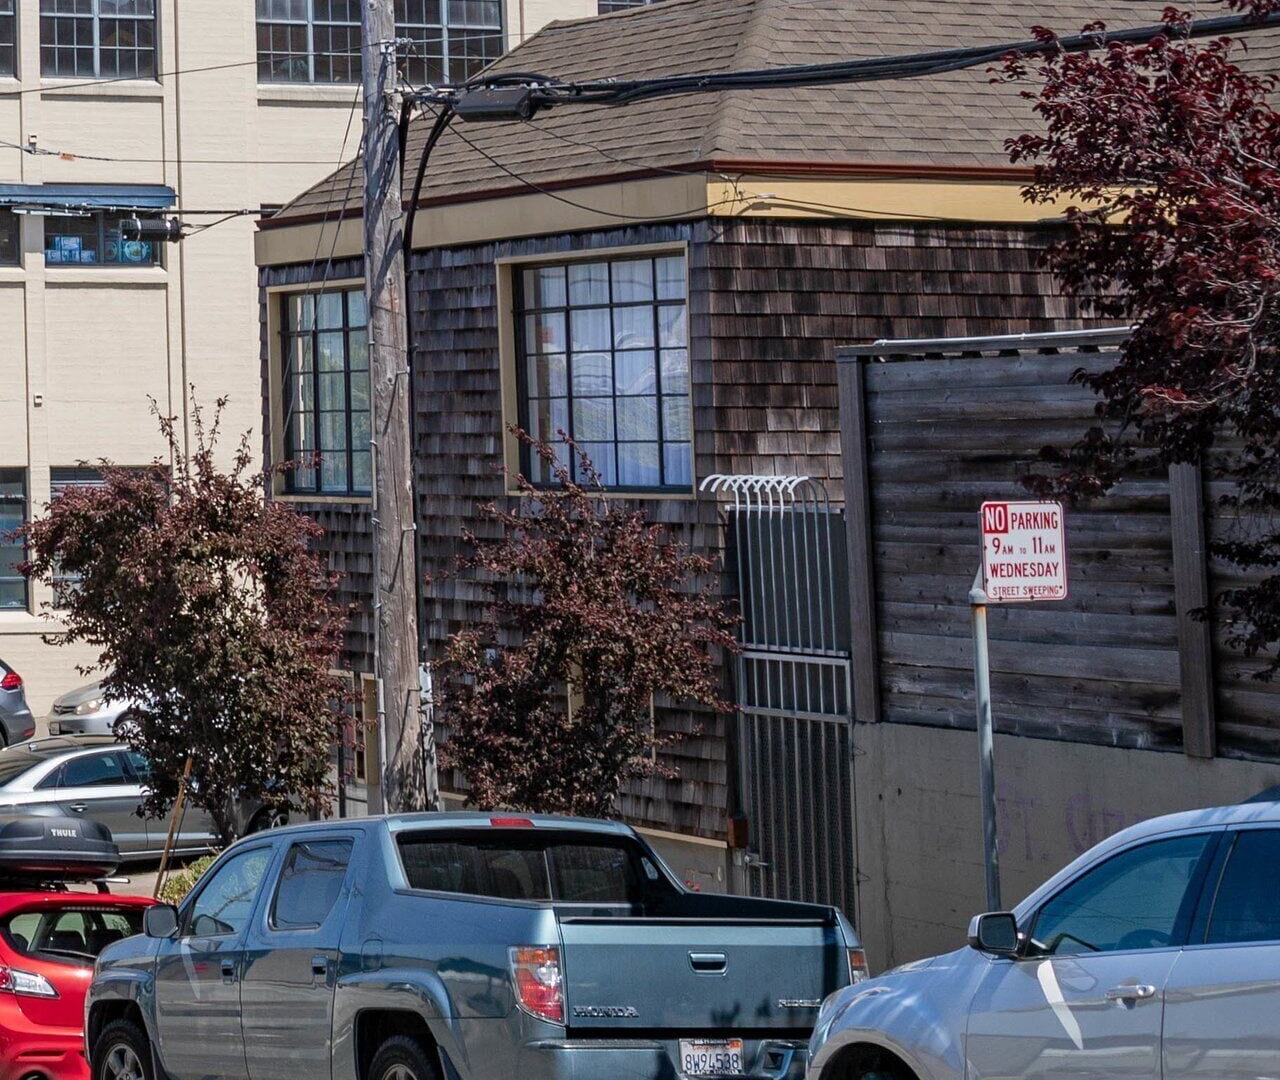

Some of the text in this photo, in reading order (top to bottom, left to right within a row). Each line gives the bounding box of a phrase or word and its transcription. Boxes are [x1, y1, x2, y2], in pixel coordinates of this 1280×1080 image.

[985, 506, 1058, 531] NO PARKING
[989, 562, 1059, 578] WEDNESDAY
[992, 585, 1059, 596] STREET SWEEPING
[50, 828, 77, 838] THULE
[572, 1005, 640, 1018] HONDA
[685, 1052, 740, 1071] 8W94538
